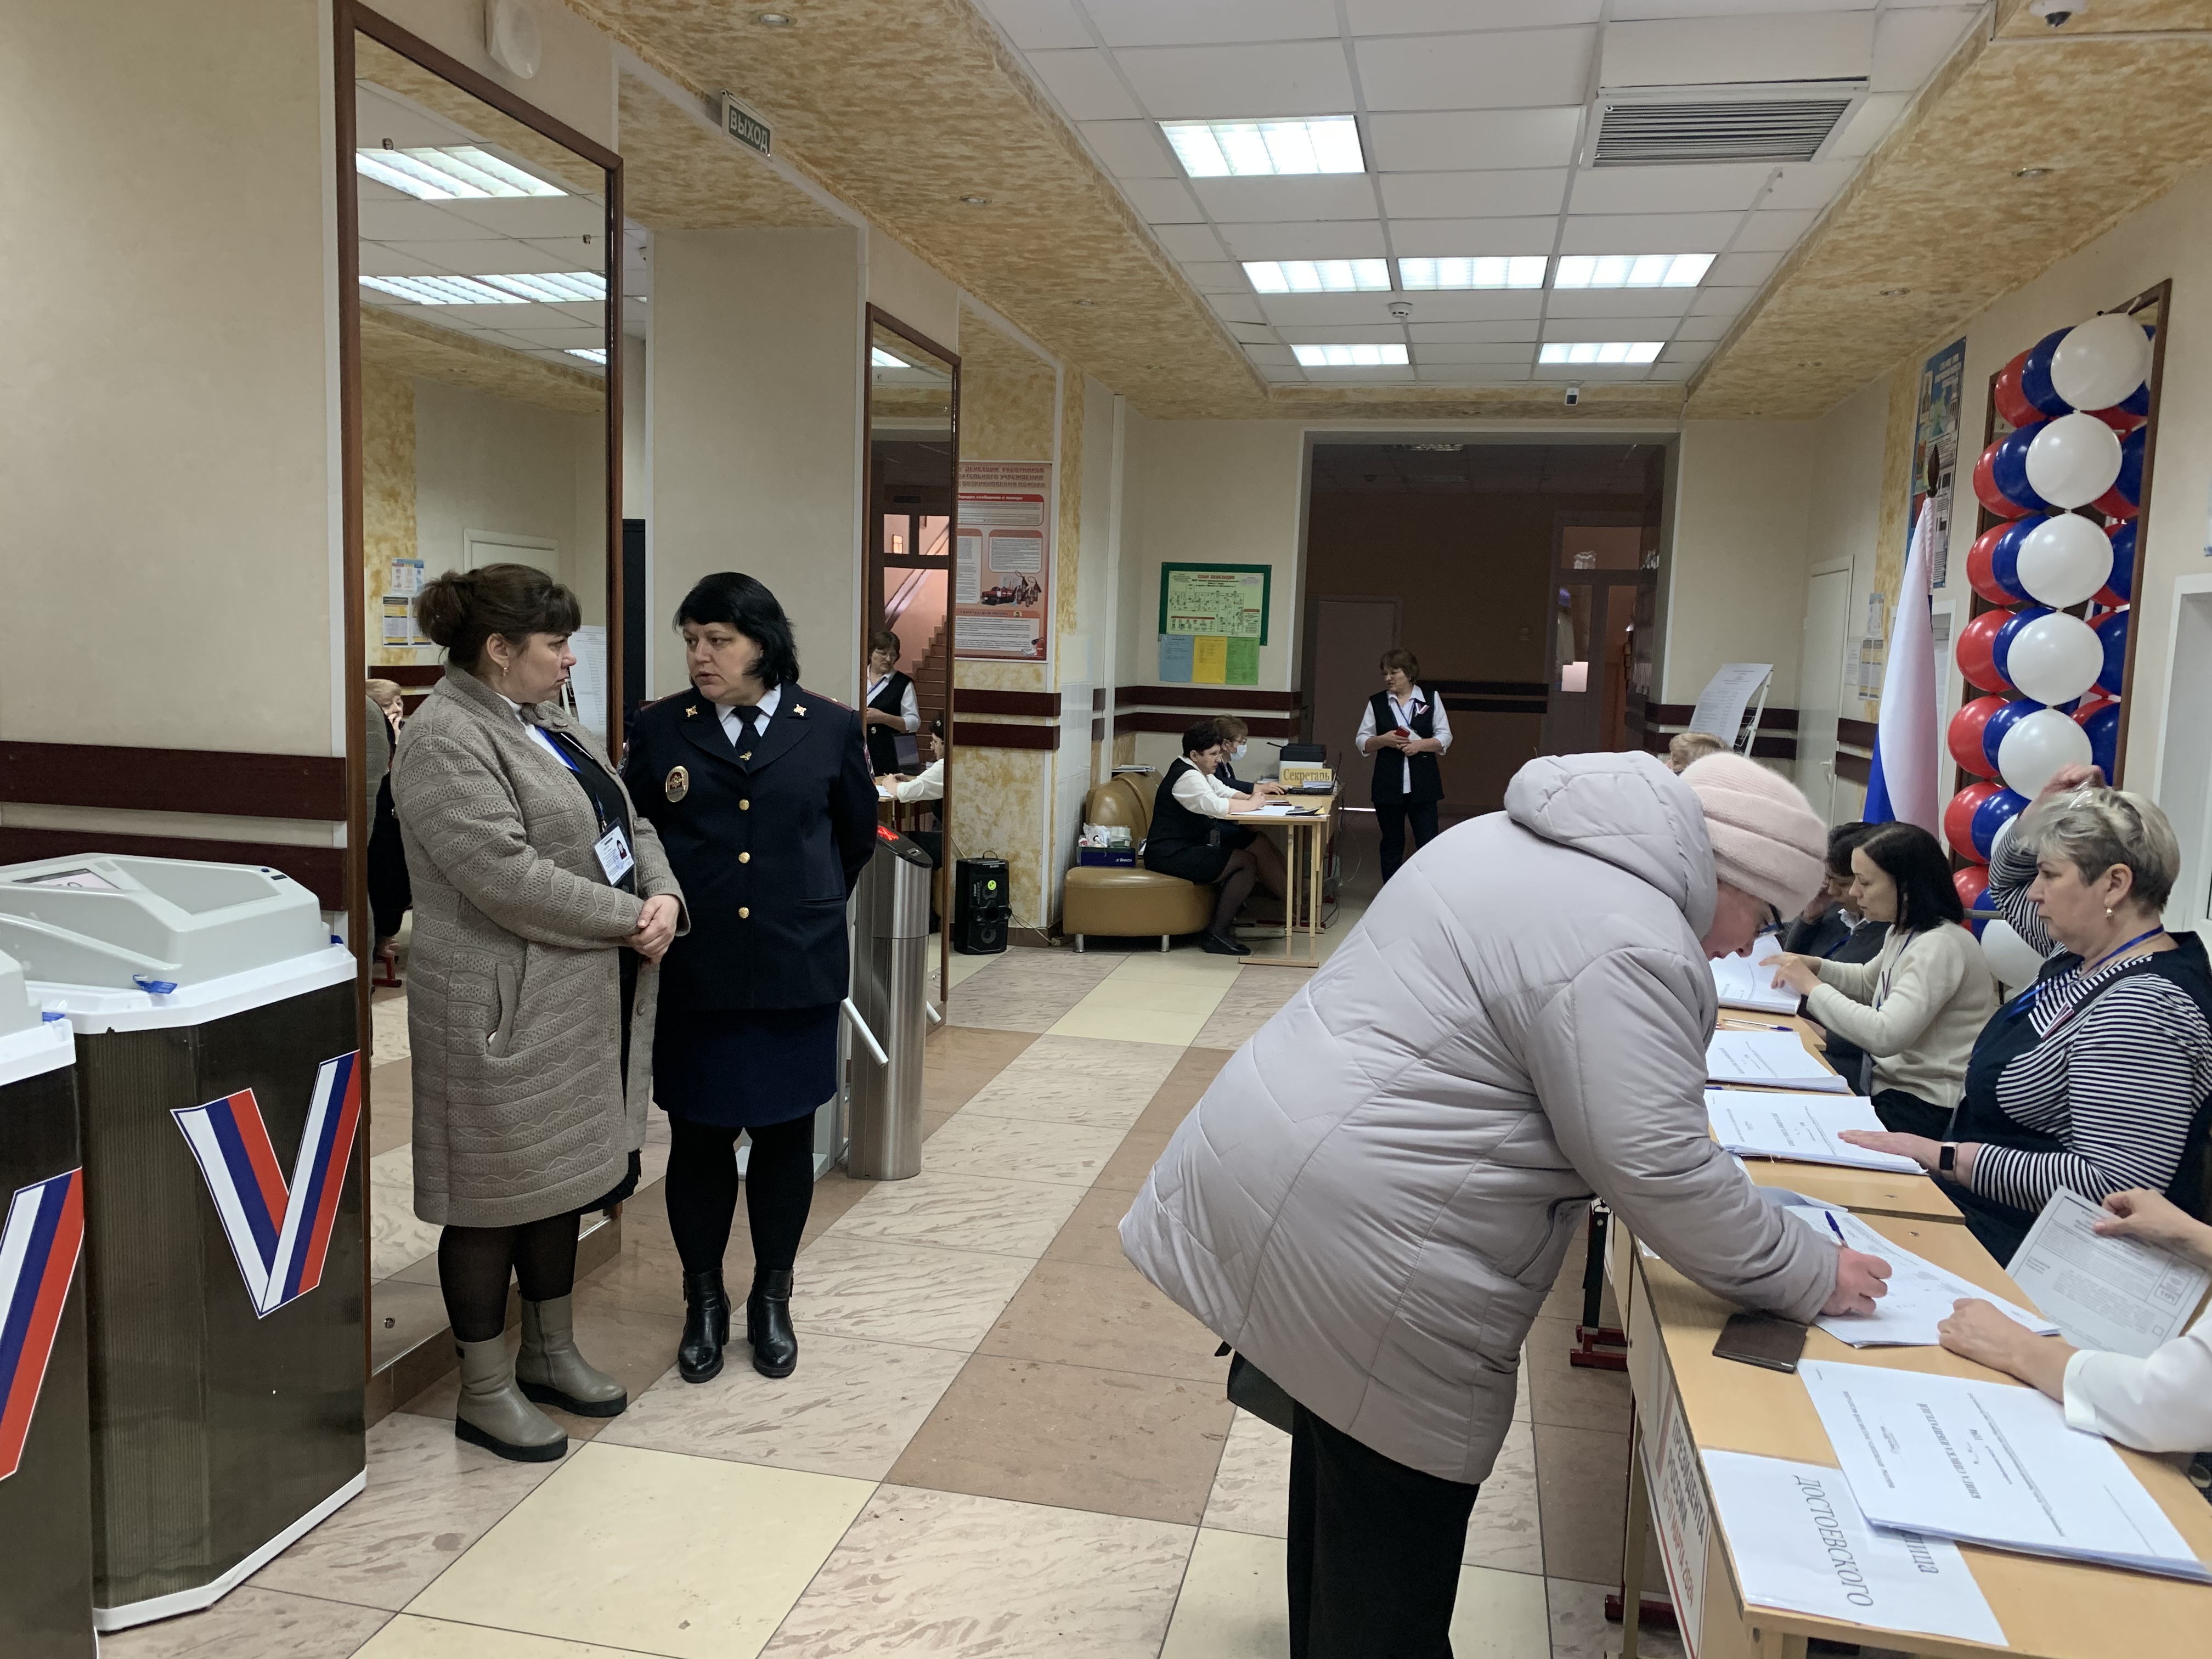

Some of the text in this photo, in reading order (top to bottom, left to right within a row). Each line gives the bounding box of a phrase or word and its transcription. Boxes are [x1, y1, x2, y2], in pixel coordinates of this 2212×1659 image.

[730, 110, 768, 154] ВЫХОД
[1283, 769, 1330, 783] Секретарь
[1667, 1447, 1688, 1532] РОССИИ
[1672, 1414, 1705, 1544] ПРЕЗИДЕНТА
[1791, 1474, 1874, 1606] ДОСТОЕВСКОГО
[1903, 1531, 1939, 1573] лица
